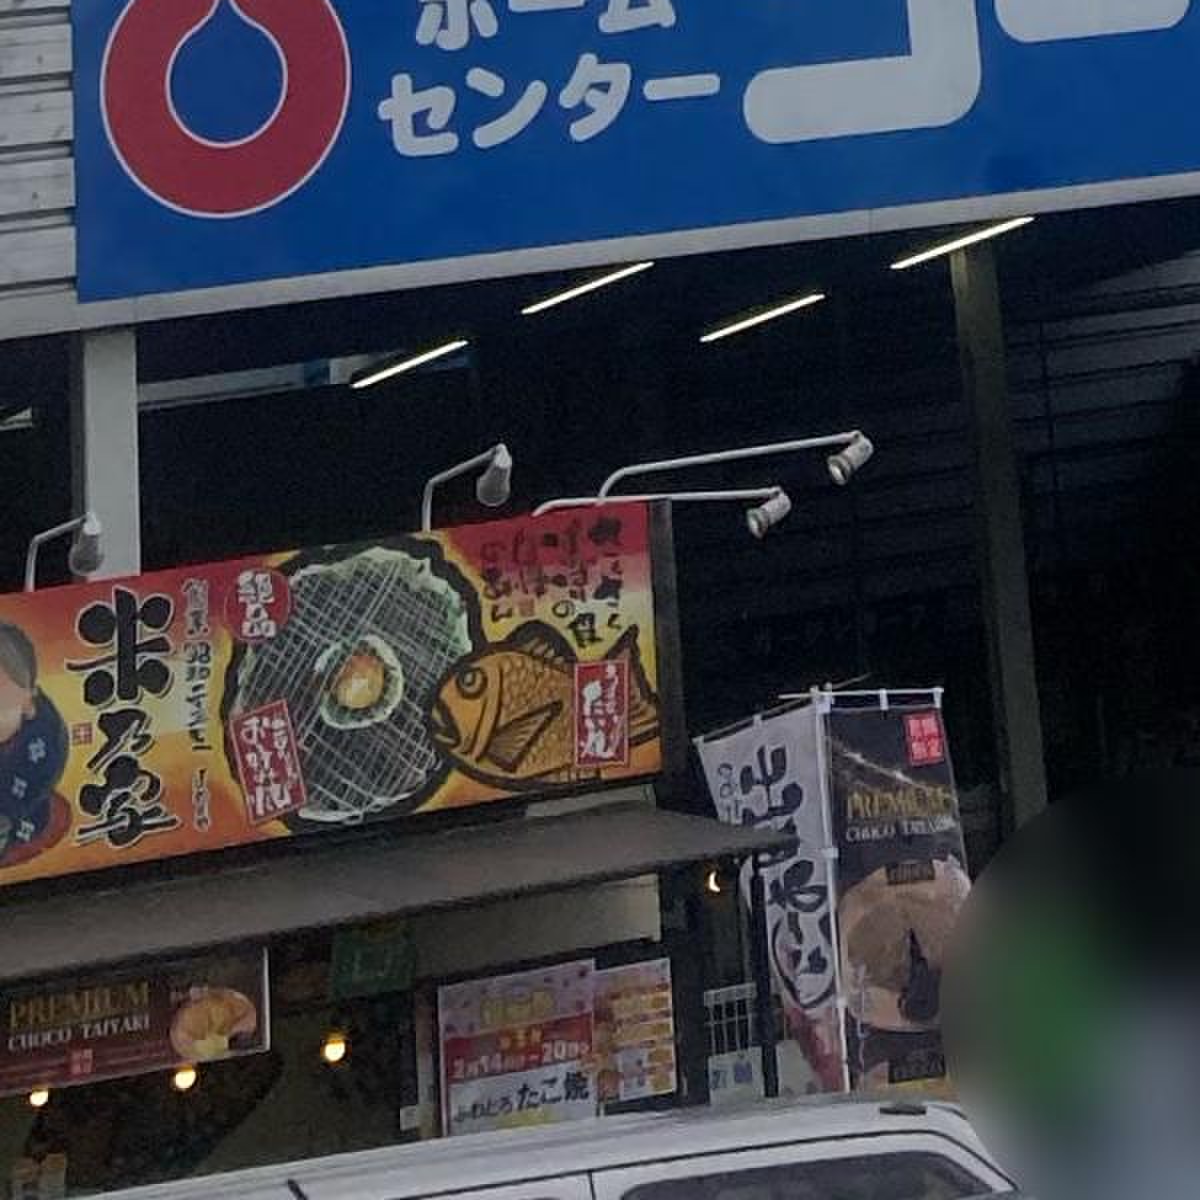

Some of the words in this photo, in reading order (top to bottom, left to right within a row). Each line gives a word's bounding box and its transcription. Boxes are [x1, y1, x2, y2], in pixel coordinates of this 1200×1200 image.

[378, 53, 721, 157] センター
[82, 1014, 150, 1040] TAIYAKI
